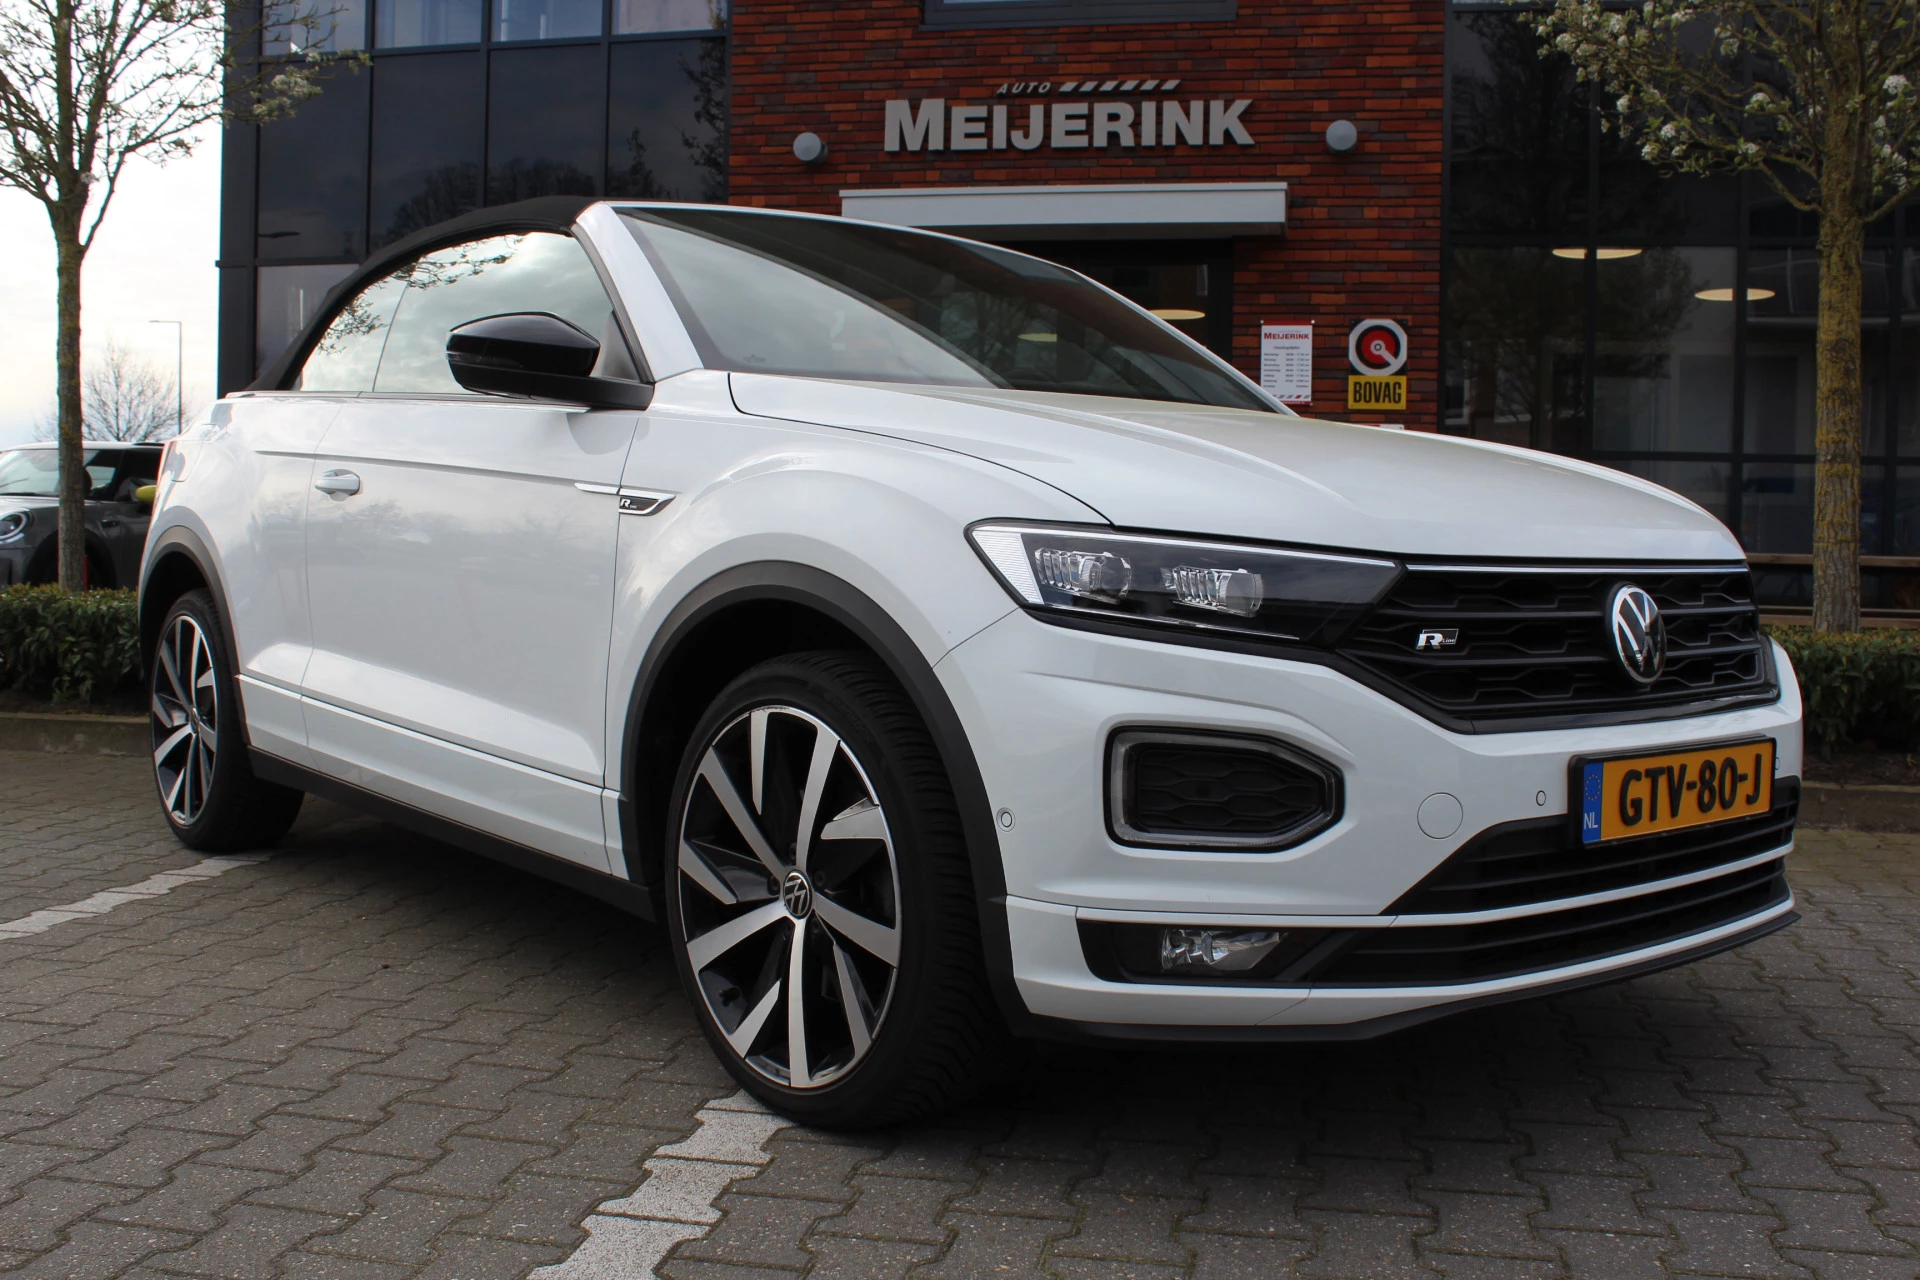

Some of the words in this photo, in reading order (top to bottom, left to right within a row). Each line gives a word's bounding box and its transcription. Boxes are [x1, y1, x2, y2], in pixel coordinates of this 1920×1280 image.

[997, 81, 1052, 95] AUTO
[884, 98, 1256, 153] MEIJERINK
[1263, 332, 1310, 340] MEIJERINK
[1353, 381, 1402, 404] BOVAG
[1619, 753, 1762, 826] GTV-80-J
[1583, 811, 1599, 830] NL
